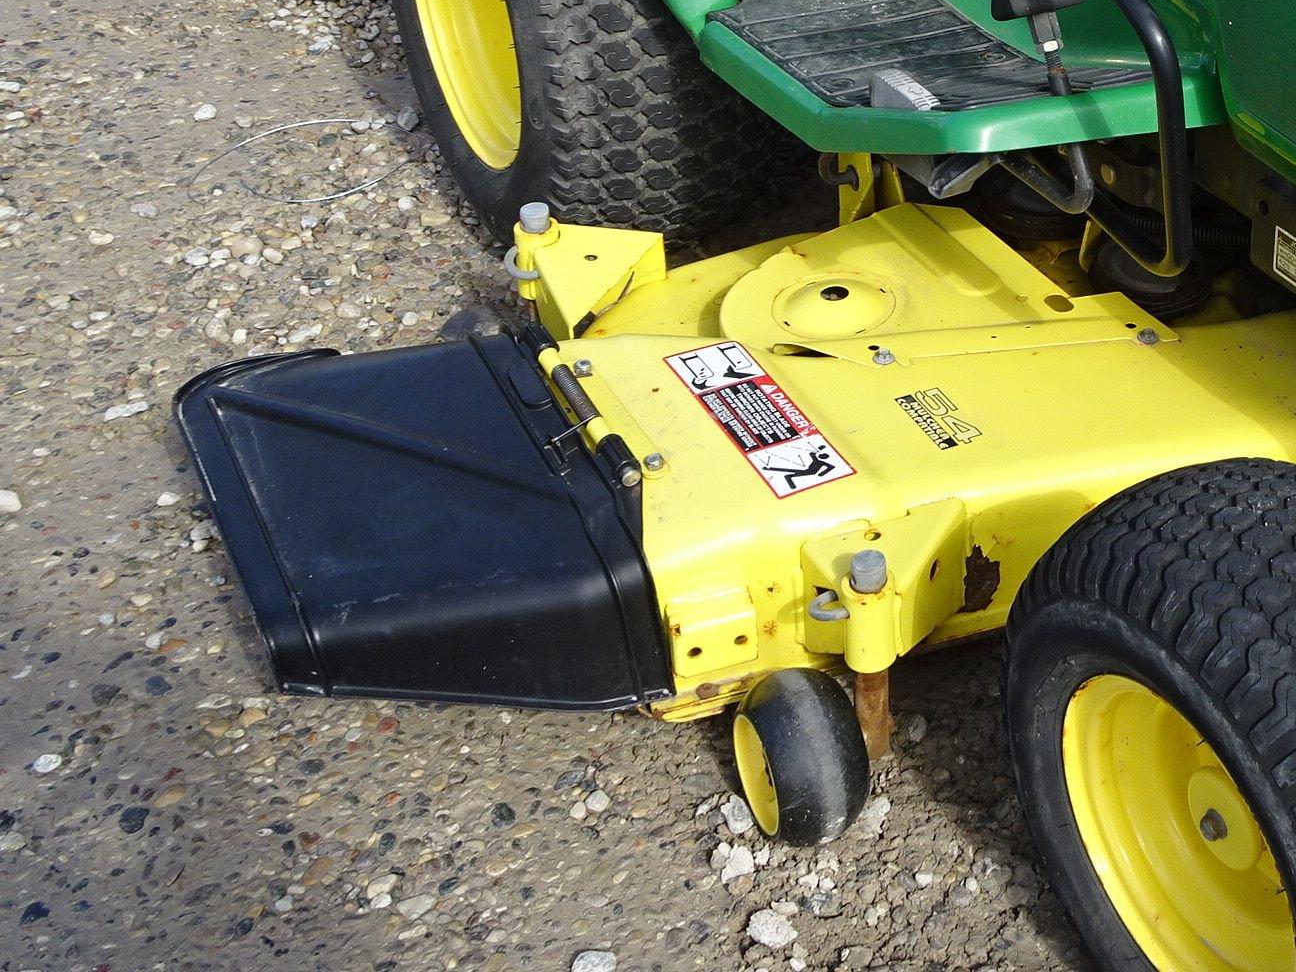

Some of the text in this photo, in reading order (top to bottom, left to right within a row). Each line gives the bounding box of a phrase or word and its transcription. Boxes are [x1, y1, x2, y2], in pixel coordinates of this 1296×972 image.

[734, 392, 756, 413] THROWN
[751, 412, 775, 434] OBJECTS
[753, 389, 791, 428] ROTATING BLADE
[770, 392, 810, 429] DANGER
[896, 397, 950, 450] COMPATIBLE
[910, 400, 950, 440] MULCHER
[914, 387, 983, 444] 54
